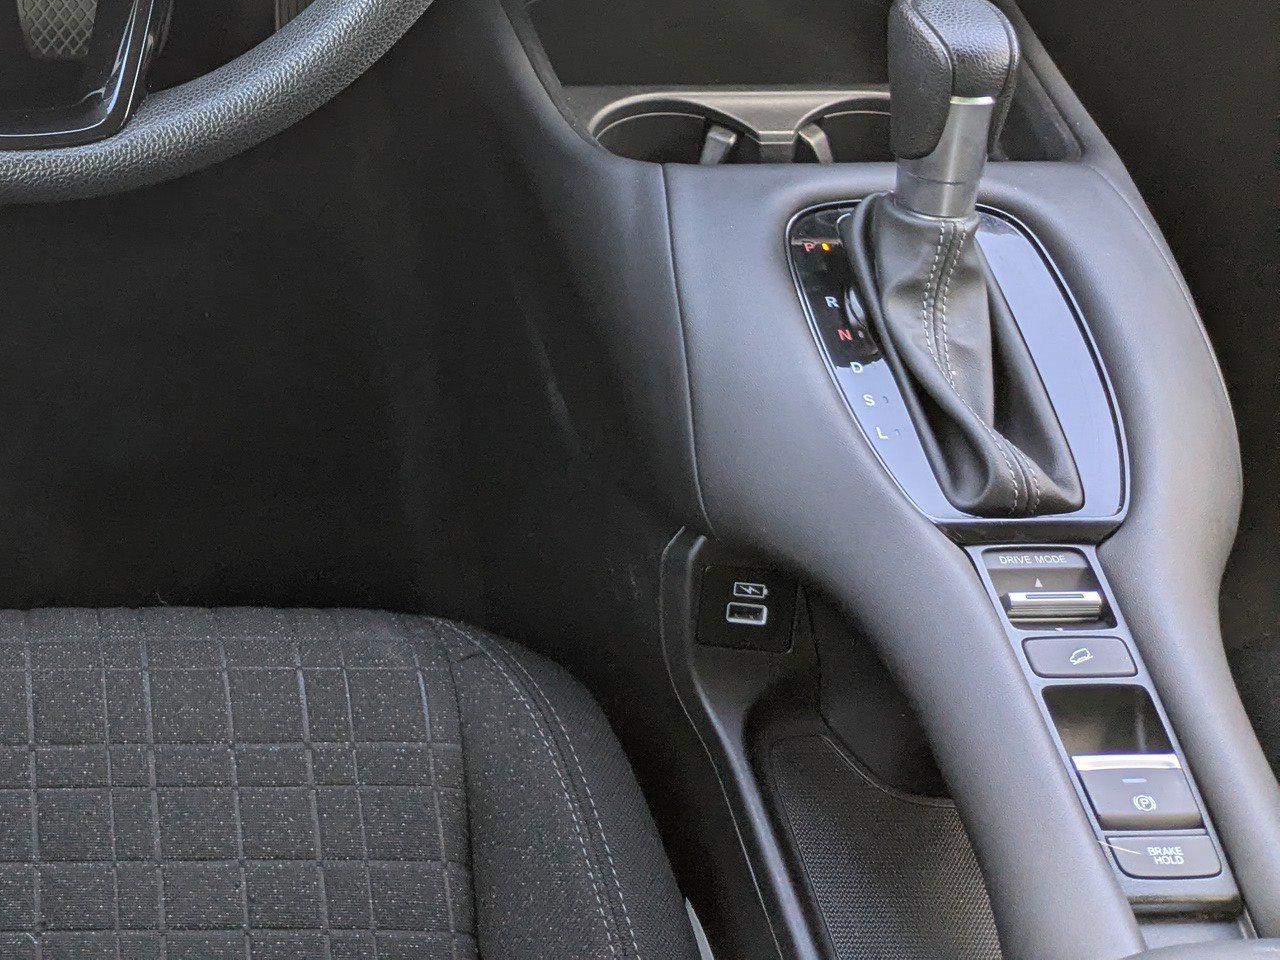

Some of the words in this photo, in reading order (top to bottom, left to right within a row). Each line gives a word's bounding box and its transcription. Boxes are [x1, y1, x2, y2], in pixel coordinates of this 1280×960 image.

[803, 242, 816, 252] P
[825, 296, 840, 308] R
[838, 329, 853, 341] N
[850, 362, 863, 373] D
[863, 394, 876, 406] S
[876, 426, 889, 439] L
[998, 555, 1032, 564] DRIVE
[1035, 555, 1068, 564] MODE
[1147, 846, 1183, 856] BRAKE
[1153, 855, 1185, 865] HOLD
